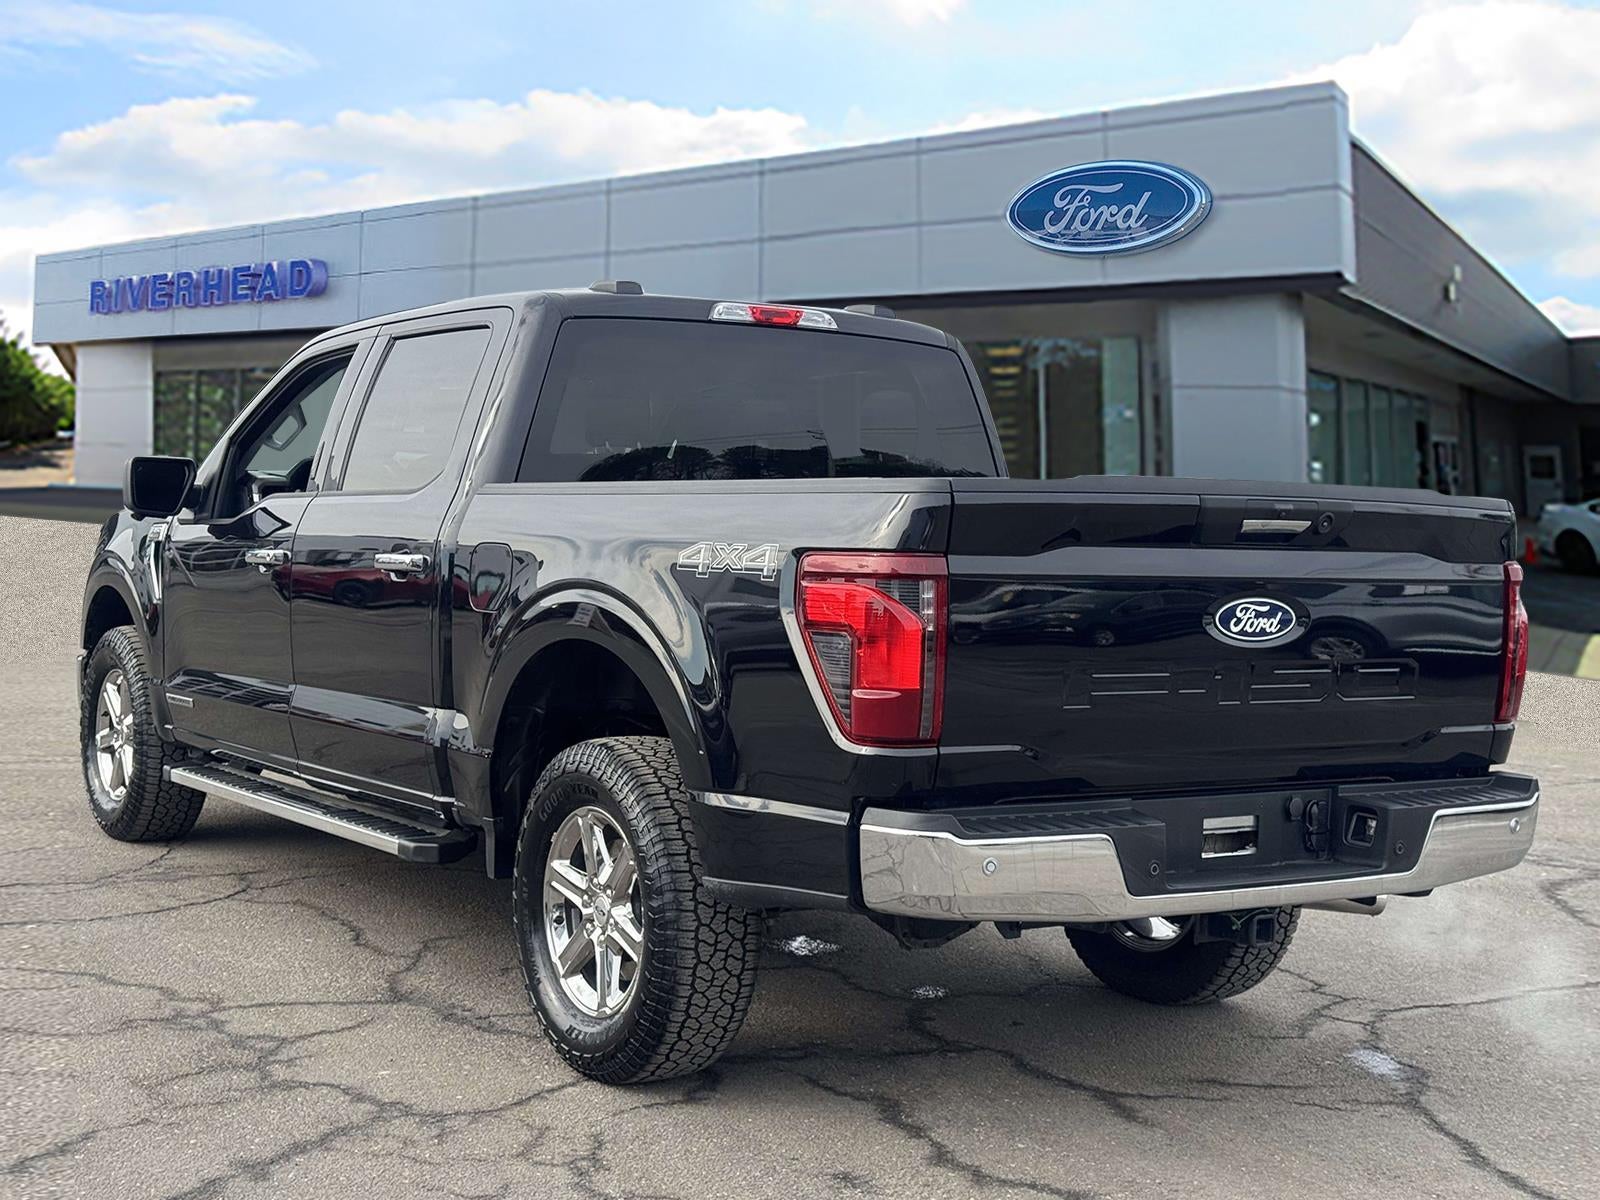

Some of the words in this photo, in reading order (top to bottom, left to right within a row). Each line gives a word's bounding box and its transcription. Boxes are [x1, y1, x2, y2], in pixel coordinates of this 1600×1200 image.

[1043, 183, 1152, 234] Ford
[89, 258, 324, 315] RIVERHEAD
[1229, 603, 1283, 633] Ford
